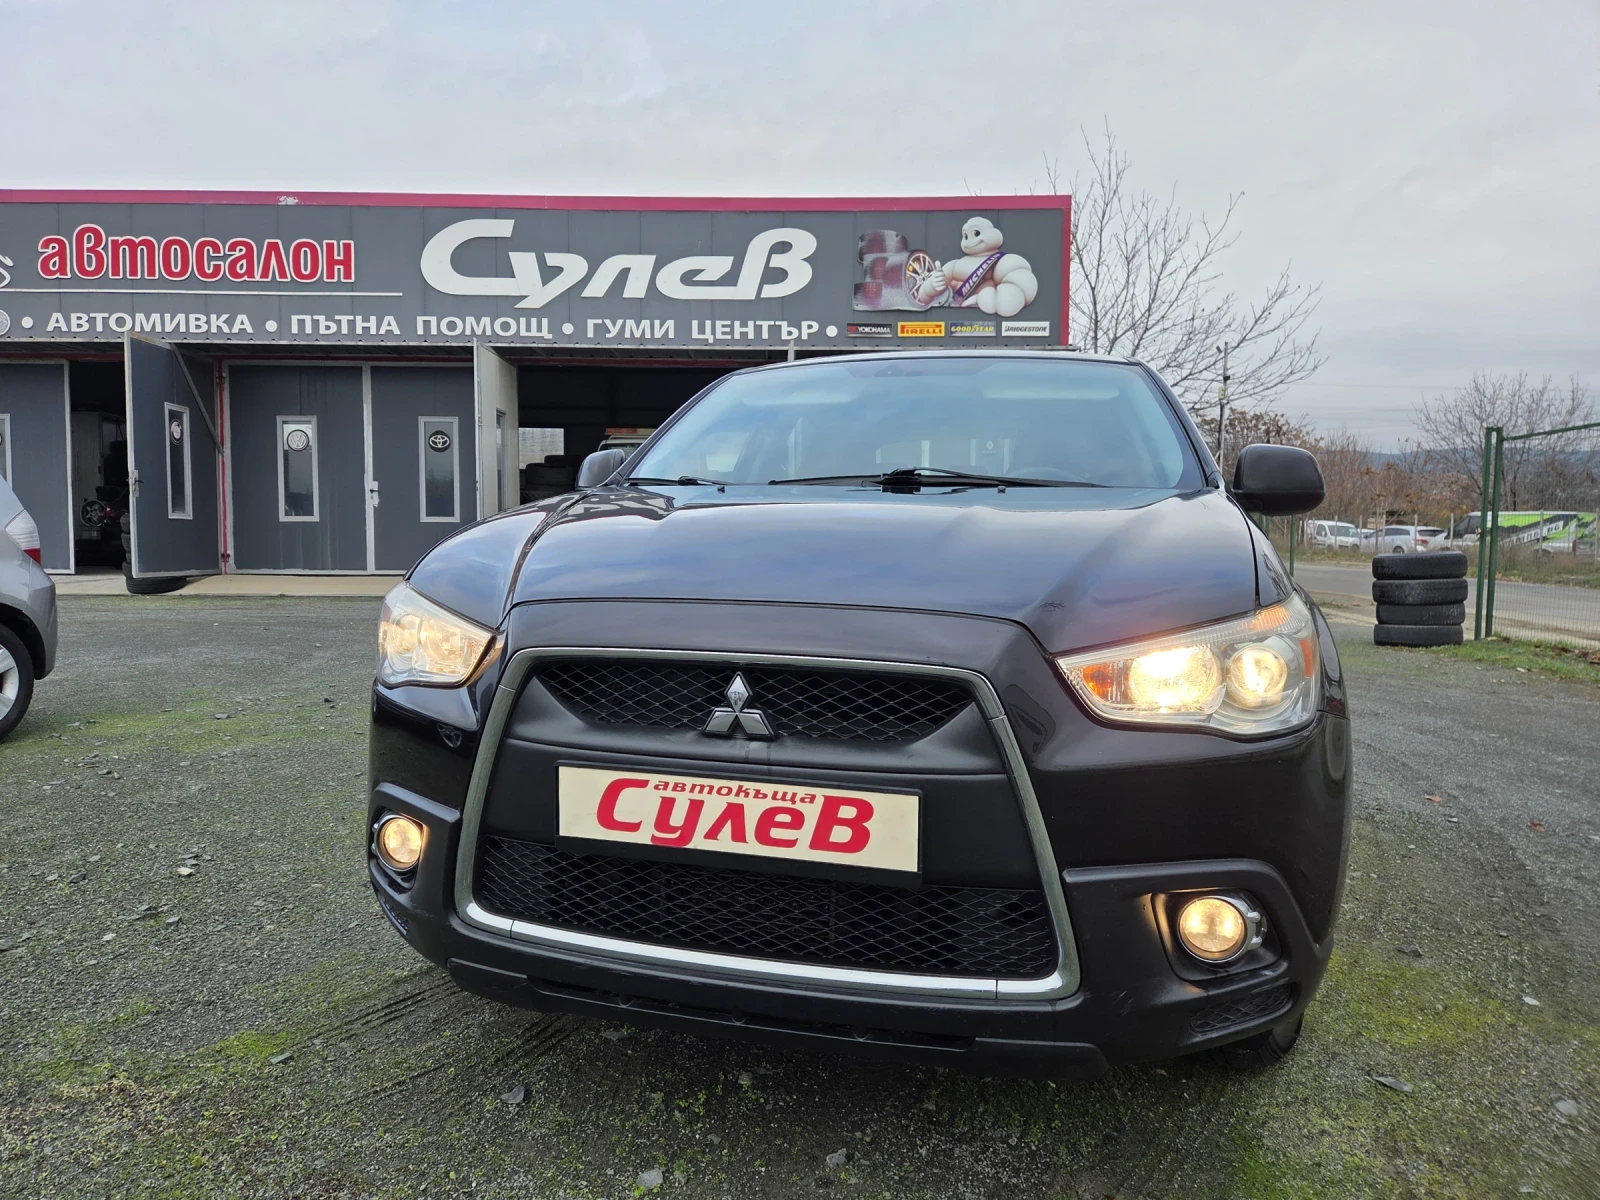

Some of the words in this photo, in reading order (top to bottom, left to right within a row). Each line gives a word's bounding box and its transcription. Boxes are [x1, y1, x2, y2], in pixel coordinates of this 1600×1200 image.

[37, 223, 355, 283] автосалон
[961, 253, 1001, 296] MICHELIN
[46, 312, 254, 334] АВТОМИВКА
[291, 314, 401, 335] ПЪТНА
[416, 316, 553, 339] ПОМОЩ
[587, 318, 675, 339] ГУМИ
[691, 320, 820, 343] ЦЕНТЪР
[900, 324, 943, 335] PIRELLI
[950, 324, 995, 333] GOODYEAR
[1004, 325, 1048, 333] BRIDGESTONE
[652, 780, 818, 805] автокъща
